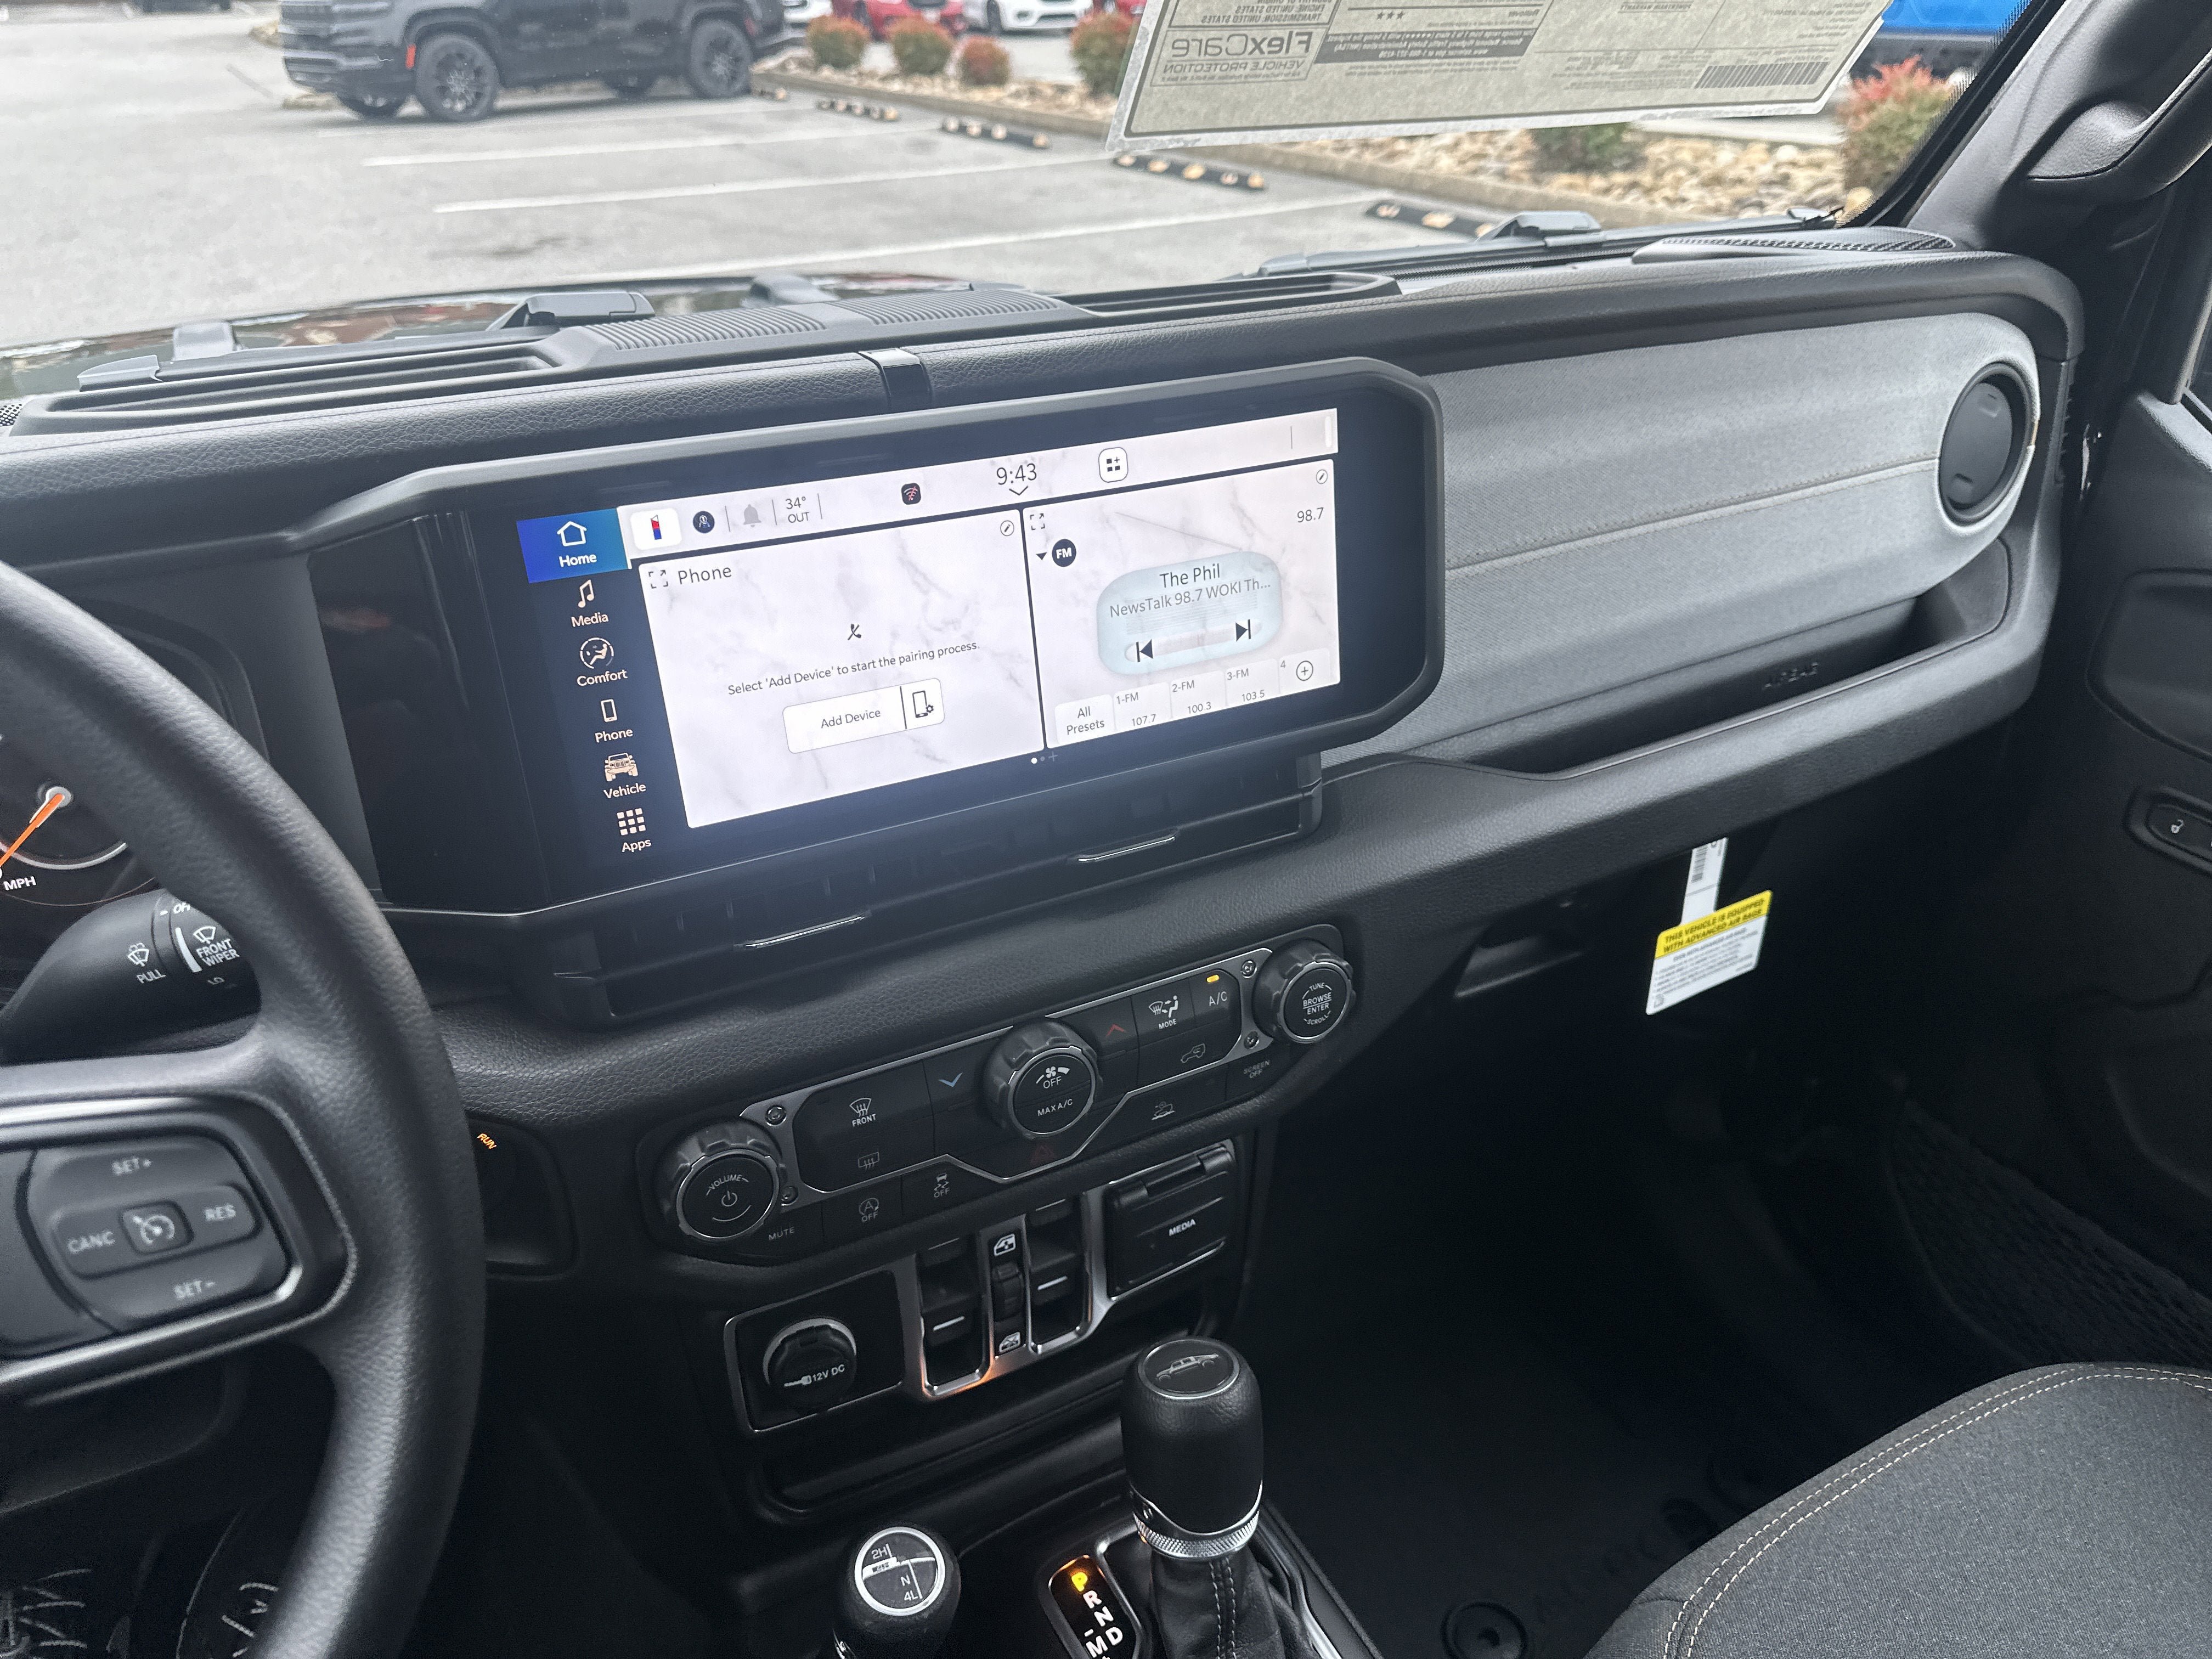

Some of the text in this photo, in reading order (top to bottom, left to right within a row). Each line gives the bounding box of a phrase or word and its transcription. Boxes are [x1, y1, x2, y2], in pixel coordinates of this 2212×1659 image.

[996, 462, 1037, 485] 9:43
[788, 511, 810, 523] OUT
[1296, 507, 1325, 524] 98.7
[559, 551, 597, 568] Home
[1056, 546, 1072, 559] FM
[678, 566, 732, 585] Phone
[1159, 563, 1221, 588] The Phil
[1110, 595, 1172, 618] NewsTalk
[1175, 589, 1203, 605] 98.7
[1205, 581, 1241, 599] WOKI
[571, 610, 609, 628] Media
[728, 640, 980, 696] Select 'Add Device' to start the pairing process.
[1280, 660, 1286, 669] 4
[577, 668, 628, 687] Comfort
[1226, 668, 1250, 681] 3-FM
[1171, 680, 1195, 693] 2-FM
[1116, 691, 1139, 705] 1-FM
[1241, 689, 1266, 702] 103.5
[1077, 706, 1091, 719] All
[1187, 701, 1212, 715] 100.3
[820, 708, 881, 729] Add Device
[1131, 713, 1156, 727] 107.7
[595, 727, 634, 743] Phone
[1066, 719, 1105, 736] Presets
[603, 781, 646, 798] Vehicle
[622, 837, 652, 854] Apps
[3, 876, 36, 891] MPH
[195, 938, 233, 958] FRONT
[201, 948, 241, 967] WIPER
[137, 969, 166, 984] PULL
[1309, 983, 1325, 992] TUNE
[1208, 991, 1228, 1008] A/C
[1302, 992, 1332, 1007] BROWSE
[1307, 1002, 1329, 1015] ENTER
[1158, 1019, 1177, 1029] MODE
[1307, 1014, 1329, 1025] SCROLL
[1243, 1059, 1271, 1075] SCREEN
[1249, 1070, 1262, 1079] OFF
[1042, 1076, 1062, 1090] OFF
[1036, 1098, 1074, 1117] MAX A/C
[851, 1113, 877, 1127] FRONT
[477, 1133, 496, 1149] RUN
[709, 1174, 742, 1189] VOLUME
[933, 1187, 950, 1199] OFF
[204, 1204, 236, 1222] RES
[860, 1211, 878, 1223] OFF
[768, 1226, 795, 1241] MUTE
[1169, 1219, 1196, 1236] MEDIA
[67, 1231, 115, 1254] CANC
[812, 1364, 845, 1381] 12V DC
[871, 1546, 888, 1560] 2H
[900, 1575, 911, 1586] N
[1071, 1572, 1088, 1592] P
[904, 1590, 918, 1601] 4L
[1082, 1590, 1102, 1609] R
[1094, 1606, 1114, 1627] N
[1105, 1627, 1123, 1646] D
[1086, 1635, 1108, 1658] M
